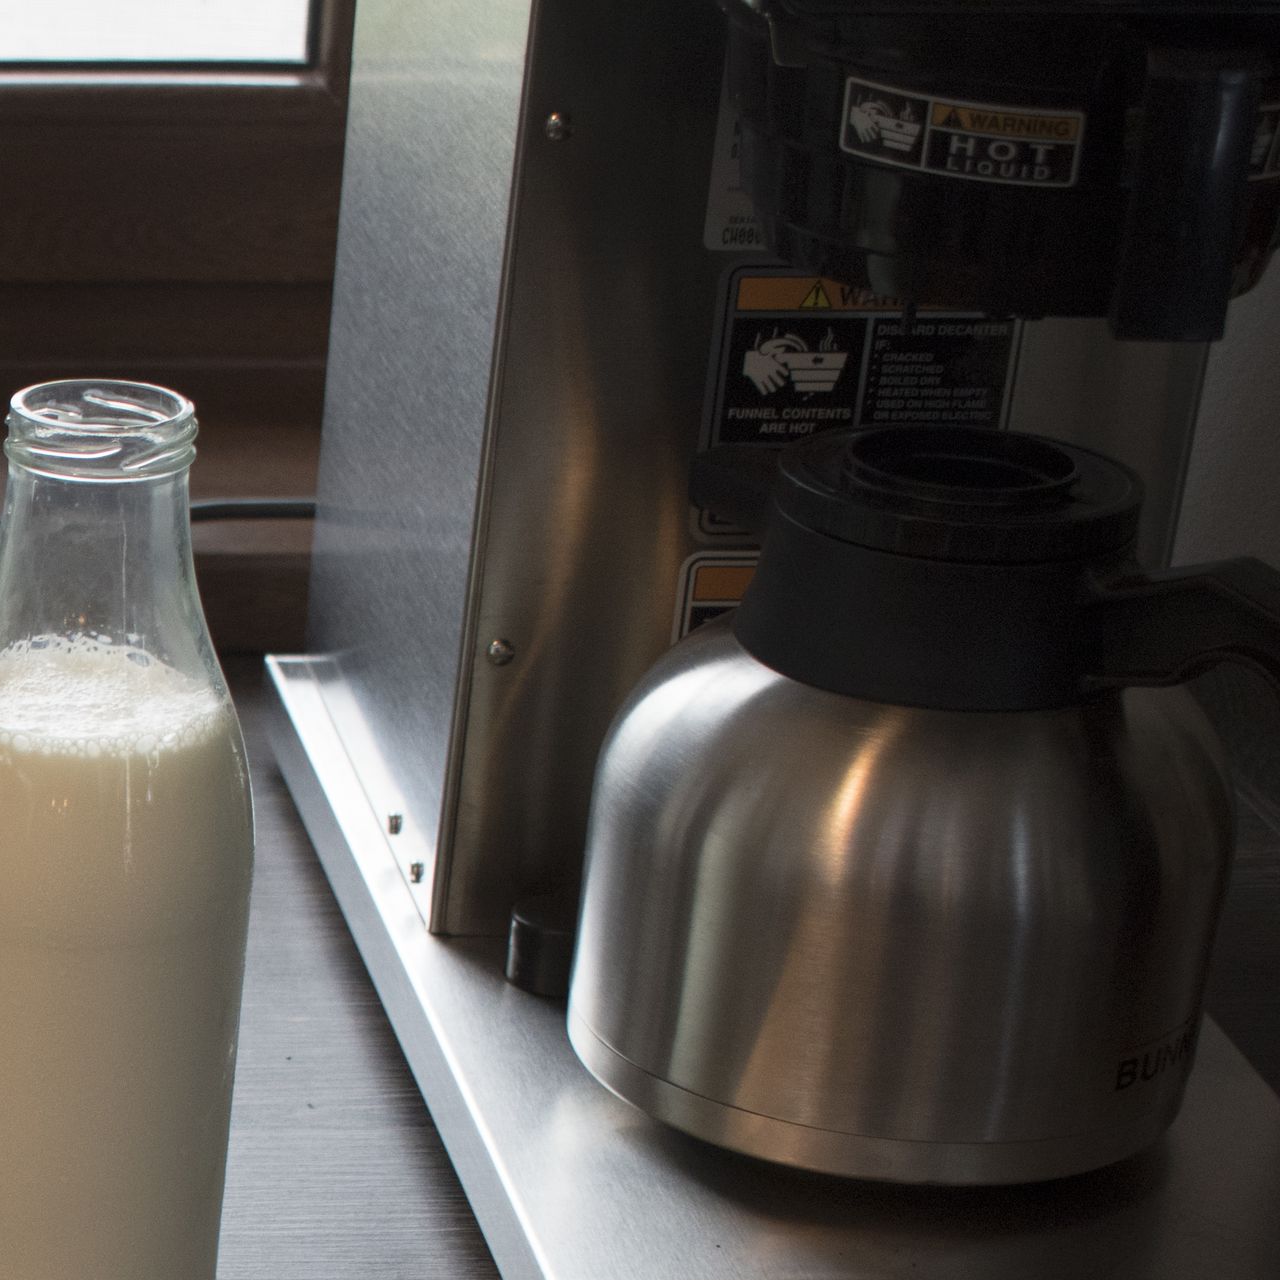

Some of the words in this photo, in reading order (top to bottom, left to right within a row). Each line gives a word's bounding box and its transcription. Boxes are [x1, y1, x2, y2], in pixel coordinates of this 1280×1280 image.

[969, 112, 1071, 137] WARNING
[948, 133, 1055, 164] HOT
[945, 156, 1052, 180] LIQUID
[936, 324, 1008, 336] DECANTER
[881, 352, 935, 362] CRACKED
[880, 364, 945, 374] SCRATCHED
[727, 407, 779, 420] FUNNEL
[781, 407, 852, 420] CONTENTS
[758, 422, 787, 434] ARE
[788, 422, 817, 434] HOT
